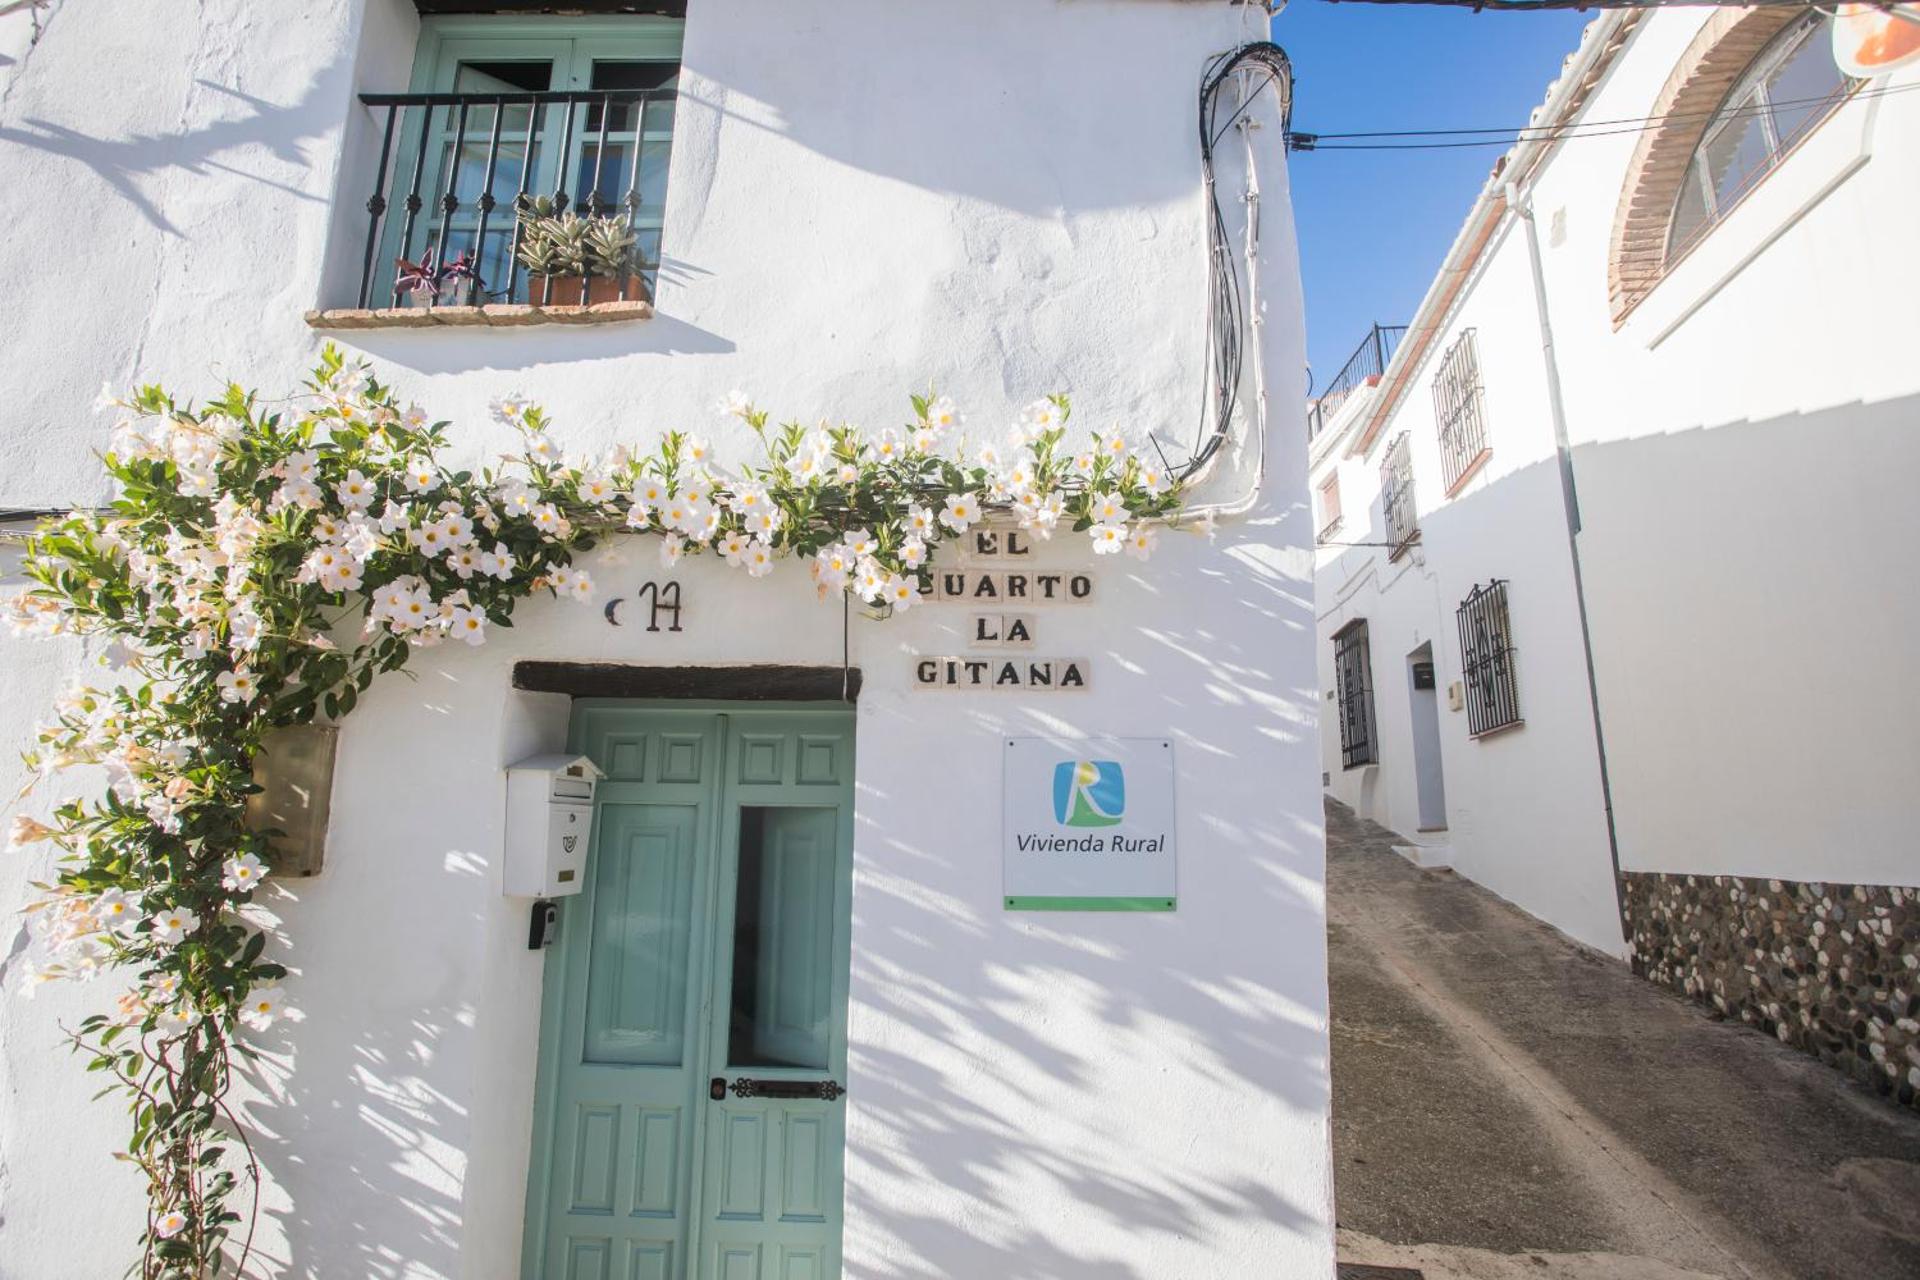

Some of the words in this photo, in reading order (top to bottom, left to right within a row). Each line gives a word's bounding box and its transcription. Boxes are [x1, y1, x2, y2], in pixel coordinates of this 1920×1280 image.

[976, 532, 1029, 555] EL
[976, 617, 1030, 642] LA
[917, 660, 1084, 686] GITANA
[1017, 833, 1104, 852] Vivienda
[1111, 833, 1165, 852] Rural
